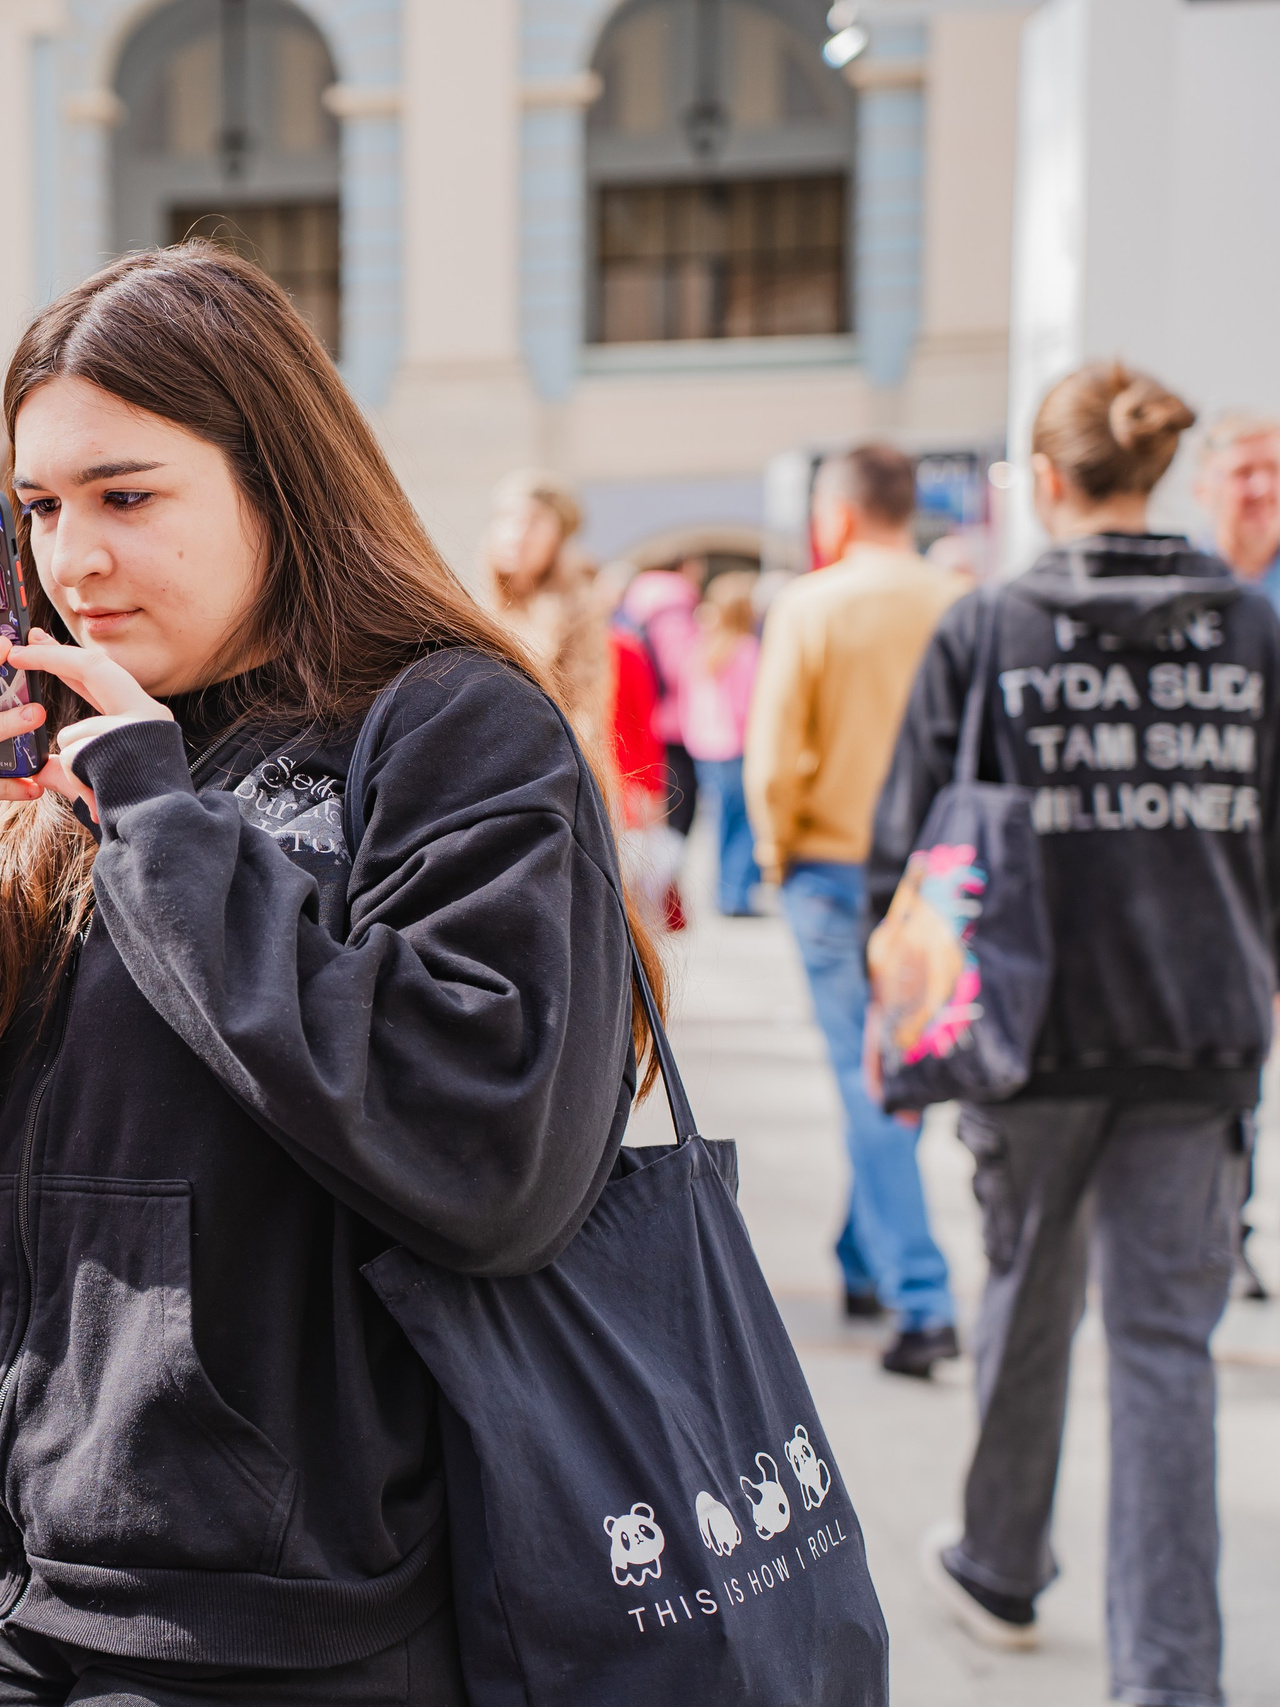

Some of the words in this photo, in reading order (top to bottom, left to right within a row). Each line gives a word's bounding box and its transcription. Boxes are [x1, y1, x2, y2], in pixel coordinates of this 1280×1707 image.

[999, 663, 1140, 718] TYDA
[1027, 722, 1137, 773] TAM
[1145, 722, 1256, 773] SIAM
[628, 1589, 718, 1633] THIS
[723, 1578, 745, 1606] IS
[747, 1555, 790, 1596] HOW
[795, 1547, 806, 1570] I
[807, 1519, 847, 1561] ROLL
